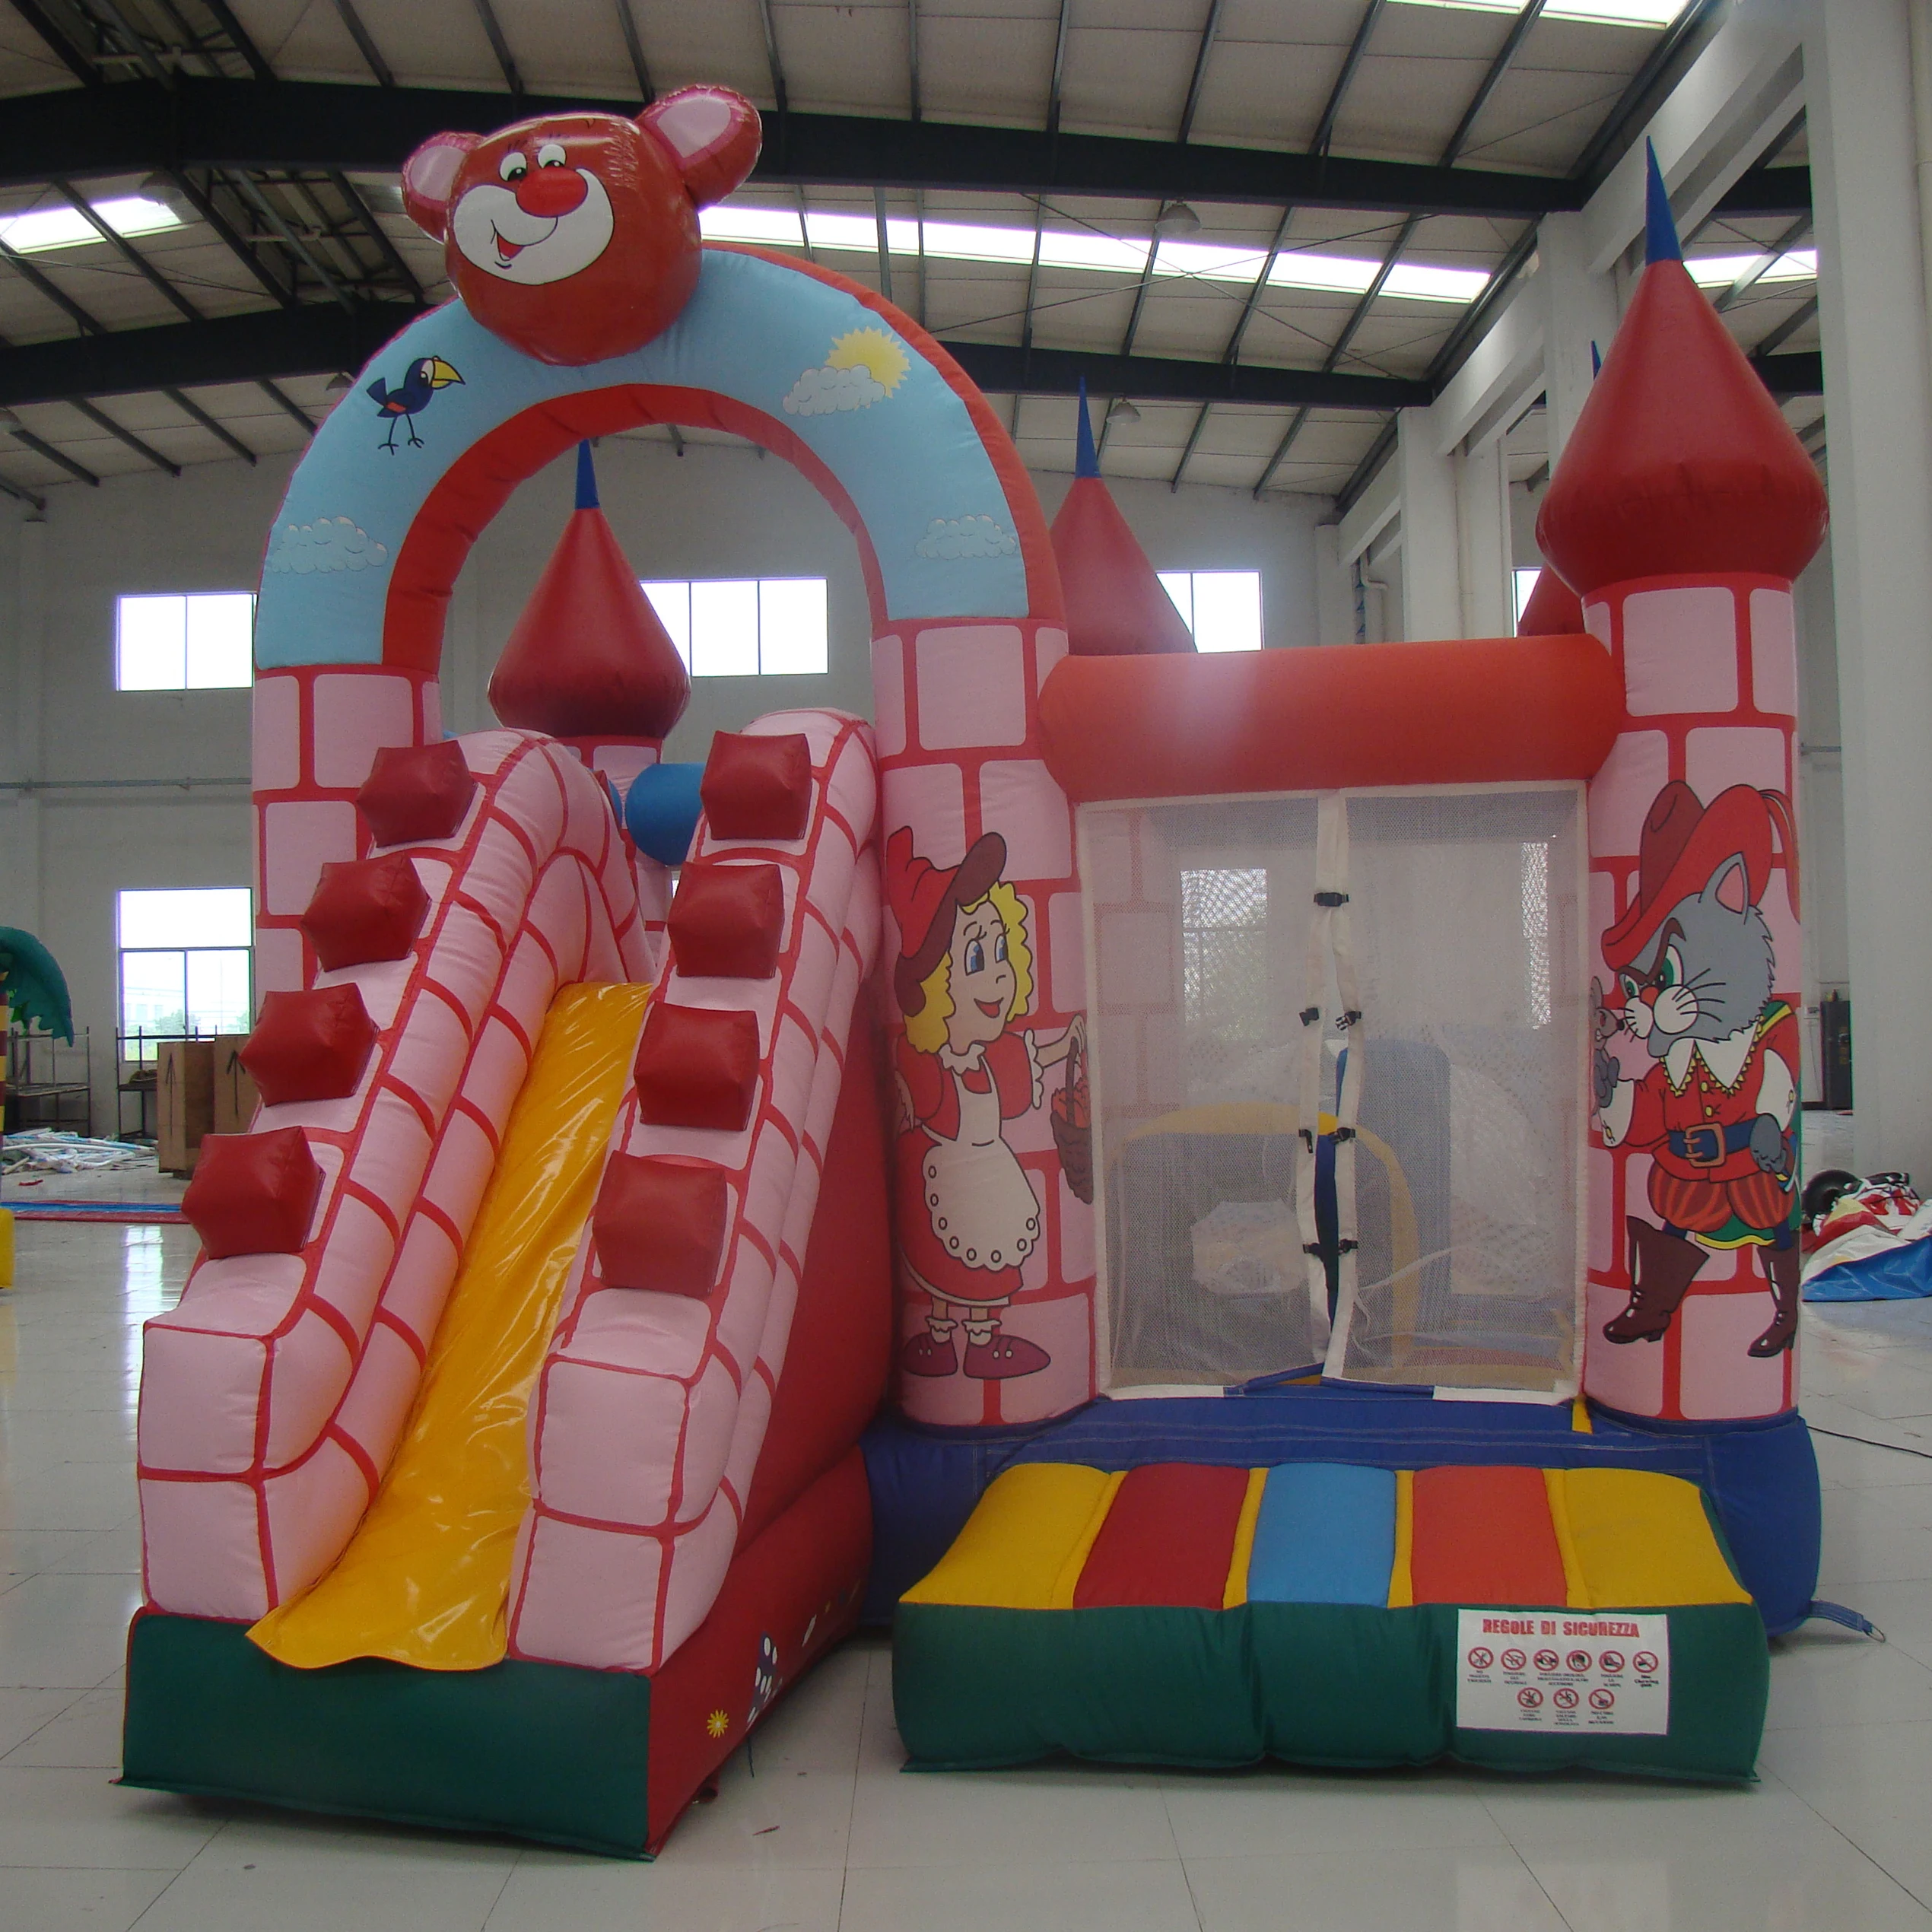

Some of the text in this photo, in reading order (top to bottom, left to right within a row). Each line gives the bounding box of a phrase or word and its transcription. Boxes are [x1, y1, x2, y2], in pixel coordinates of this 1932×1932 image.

[1482, 1619, 1640, 1638] REGOLE DI SICUREZZA
